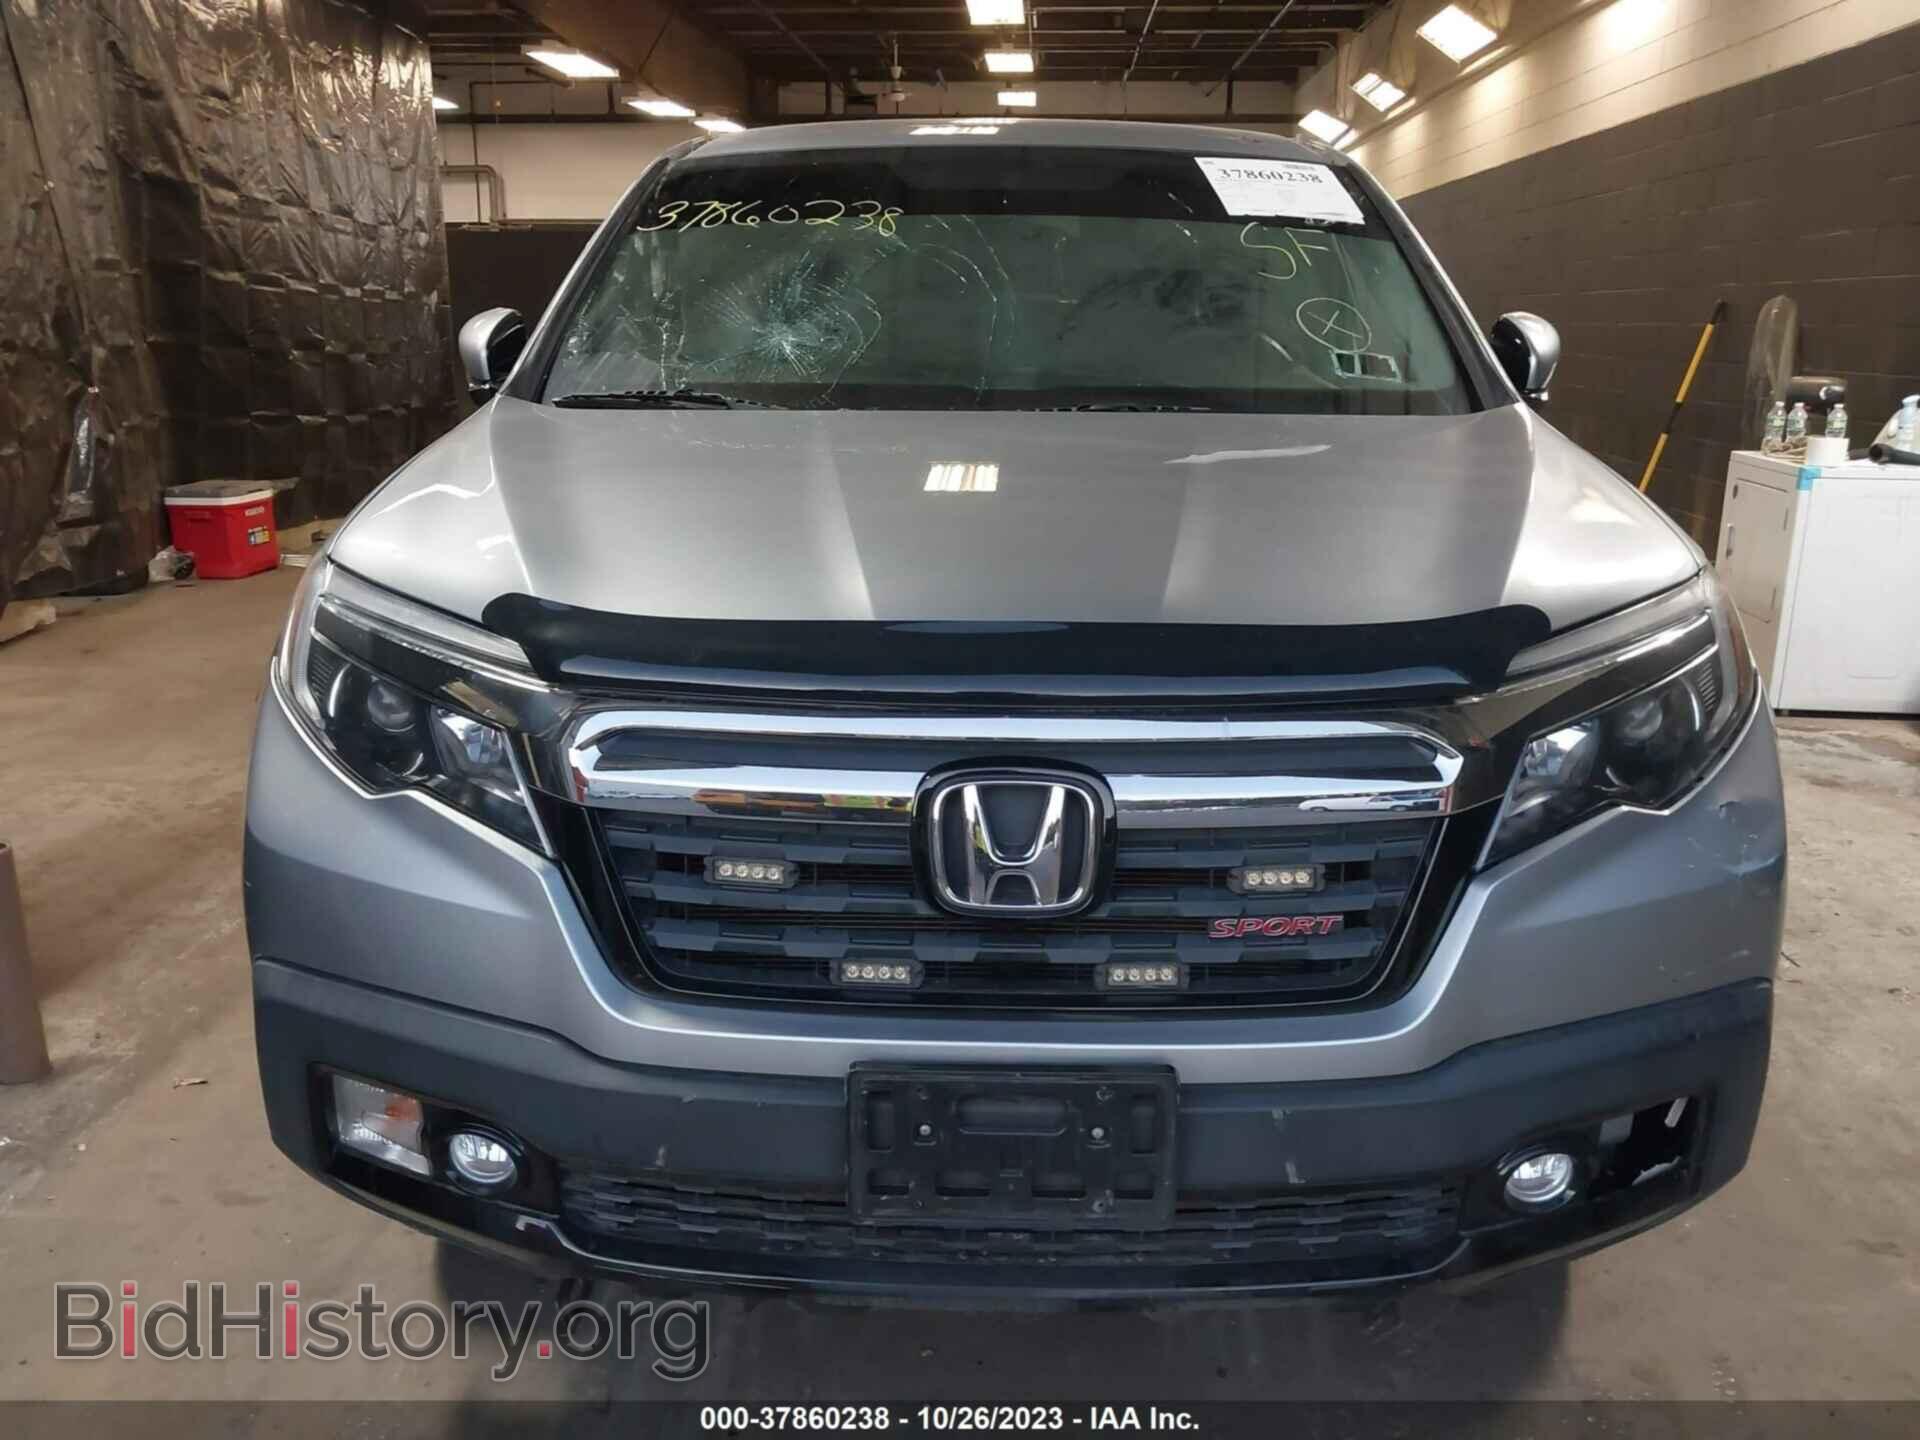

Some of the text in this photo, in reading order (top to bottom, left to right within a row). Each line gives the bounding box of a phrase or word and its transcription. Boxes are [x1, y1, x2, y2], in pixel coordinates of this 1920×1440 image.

[1217, 167, 1323, 184] 37860238
[636, 199, 905, 237] 37860238
[1208, 914, 1345, 939] SPORT
